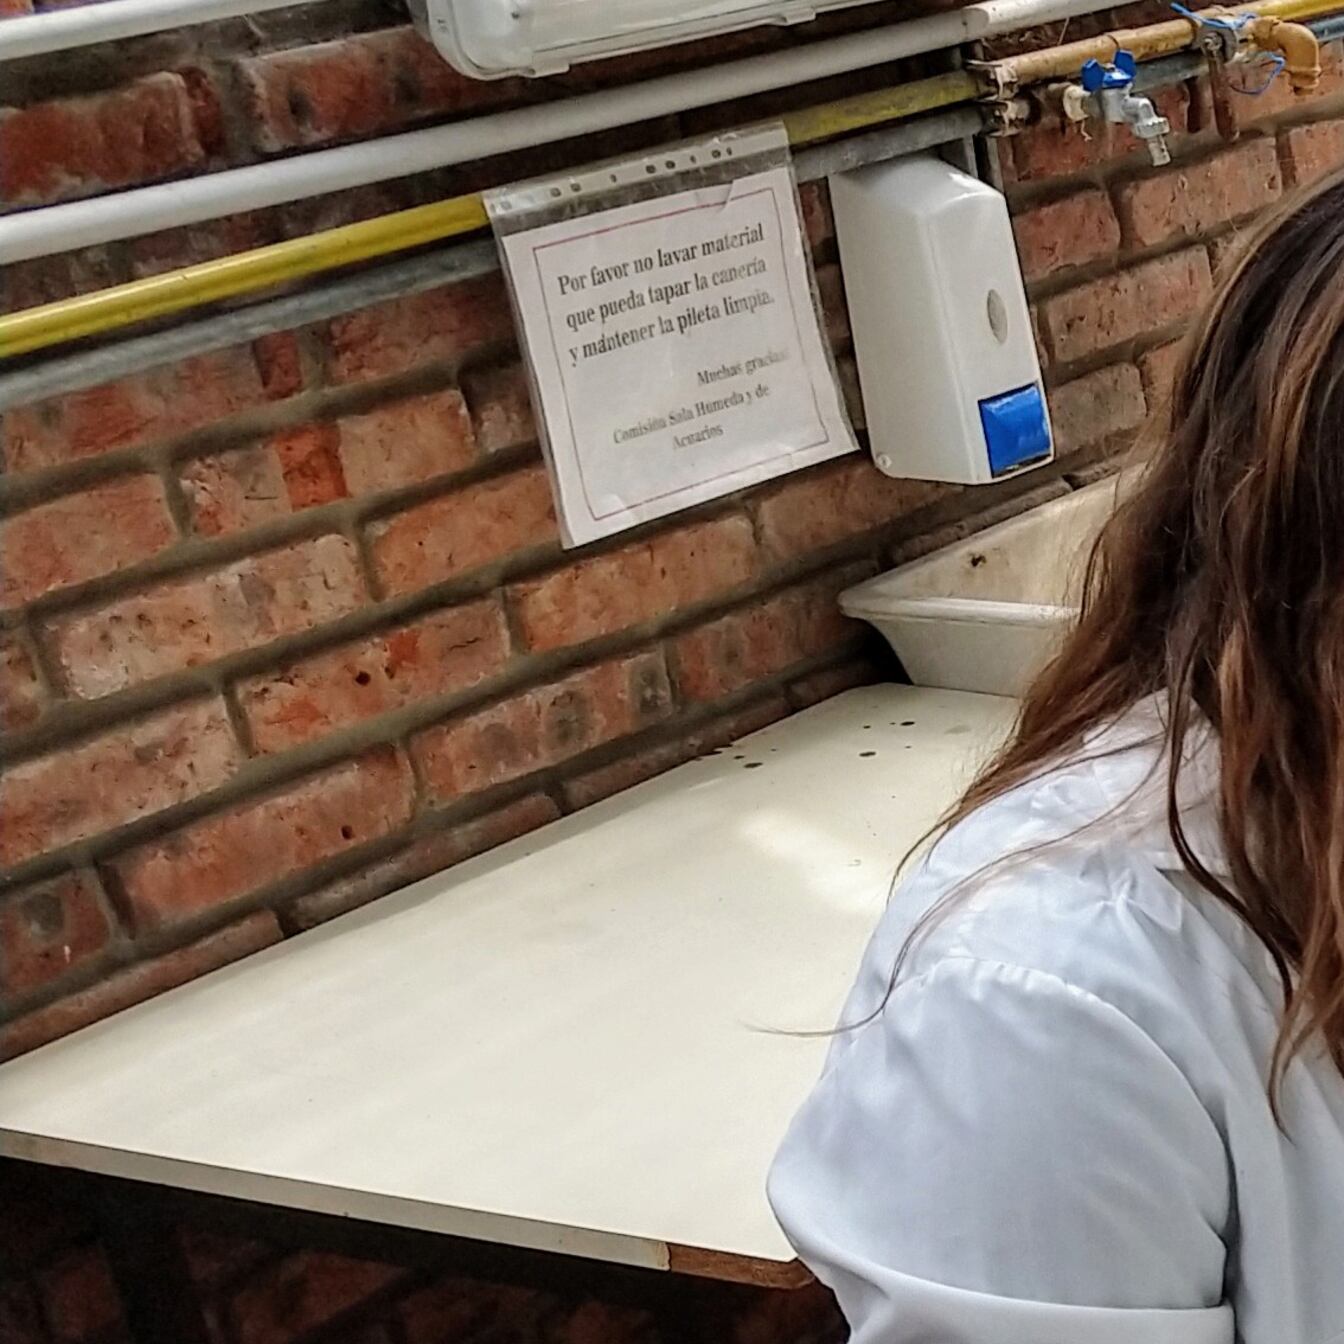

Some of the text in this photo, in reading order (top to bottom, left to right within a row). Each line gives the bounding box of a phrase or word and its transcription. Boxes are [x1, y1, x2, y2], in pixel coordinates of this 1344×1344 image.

[557, 223, 765, 295] Por favor no lavar material
[566, 256, 767, 332] que pueda tapar la canería
[569, 288, 775, 366] y mantener la pileta limpia.
[697, 362, 742, 386] Muchas
[668, 407, 695, 426] Sala
[745, 390, 753, 405] y
[754, 384, 770, 398] de
[673, 423, 724, 450] Acuarios
